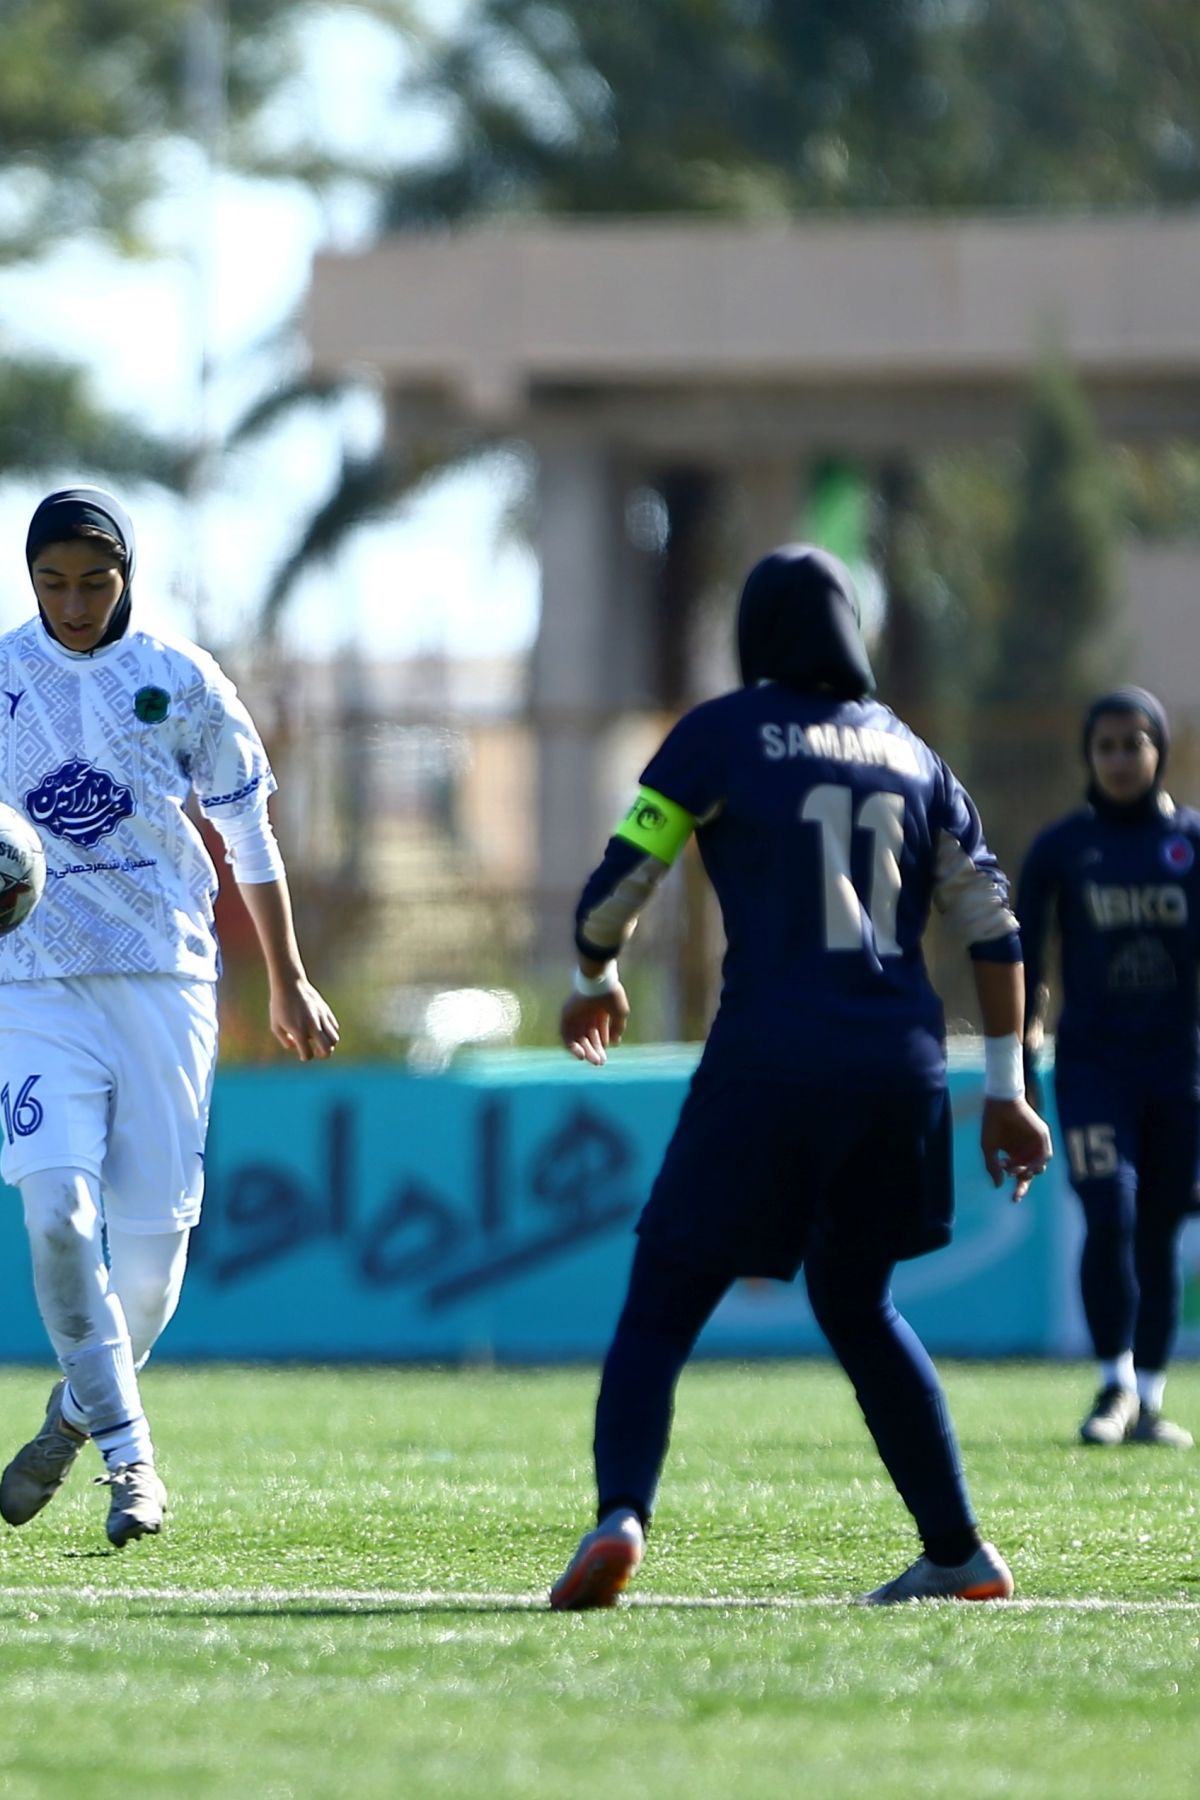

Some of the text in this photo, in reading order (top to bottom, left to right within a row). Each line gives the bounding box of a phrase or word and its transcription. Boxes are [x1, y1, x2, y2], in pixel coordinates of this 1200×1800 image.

[802, 783, 903, 957] 11
[0, 1074, 43, 1146] 16
[1066, 1123, 1119, 1182] 15
